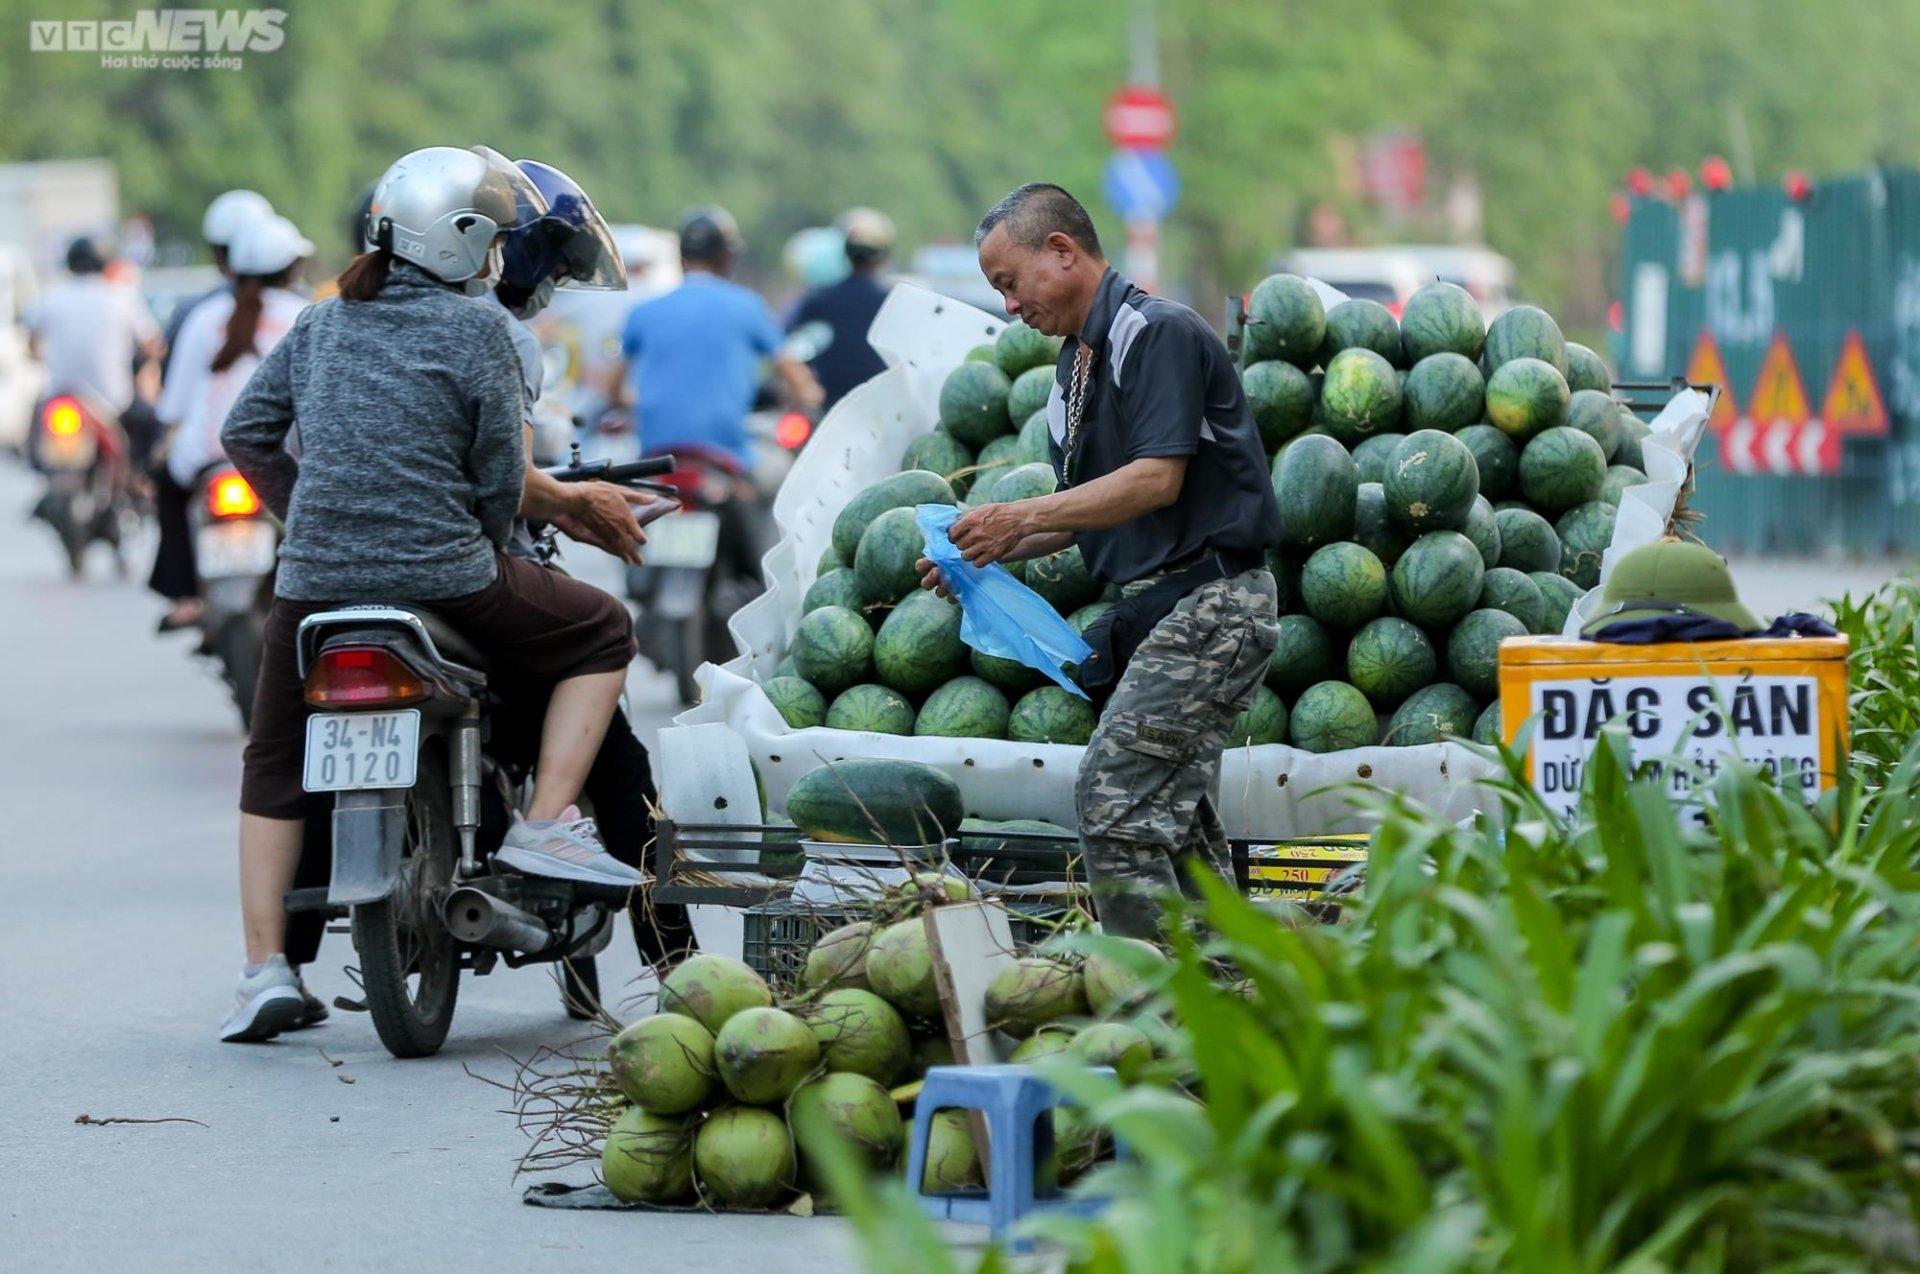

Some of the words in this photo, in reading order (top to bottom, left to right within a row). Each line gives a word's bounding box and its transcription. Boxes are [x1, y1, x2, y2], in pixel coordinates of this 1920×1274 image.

[1686, 667, 1811, 737] SẢN
[323, 716, 401, 749] 34-N4
[322, 751, 400, 784] 0120
[1543, 754, 1588, 793] DỪ
[1283, 869, 1309, 881] 250
